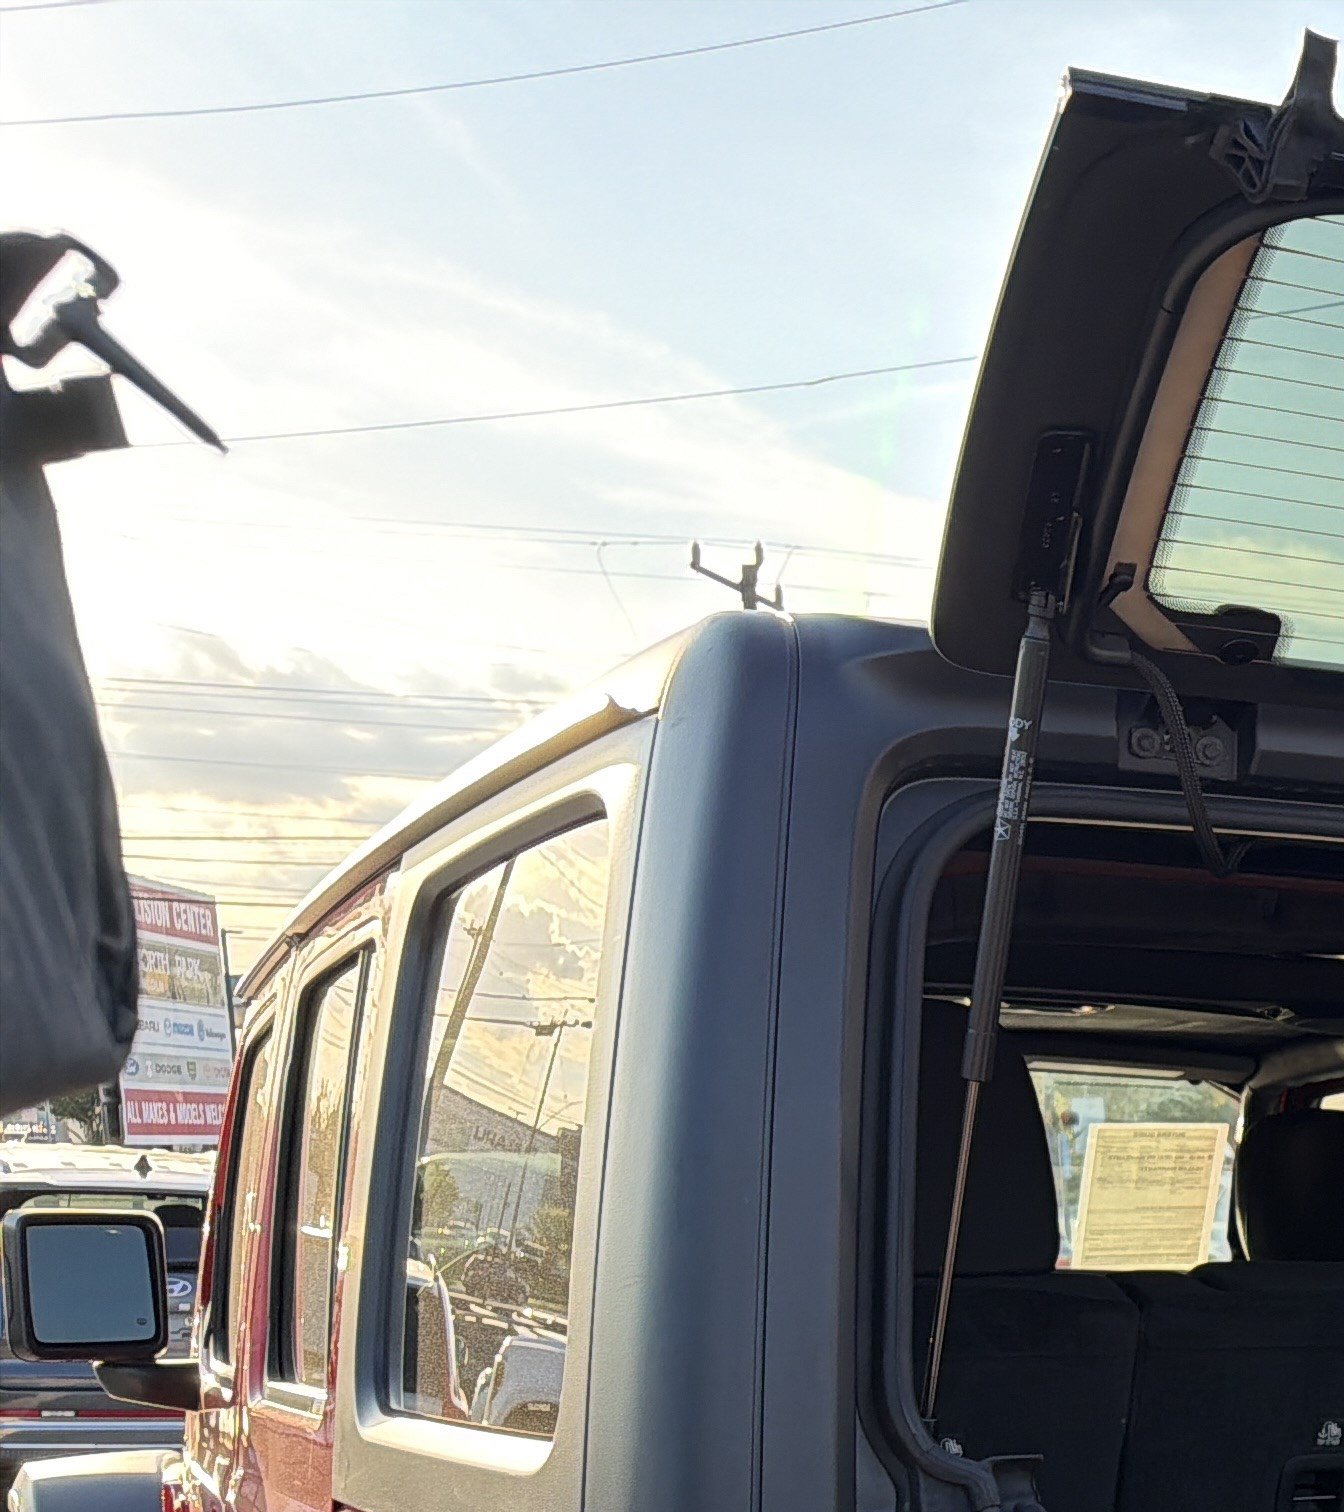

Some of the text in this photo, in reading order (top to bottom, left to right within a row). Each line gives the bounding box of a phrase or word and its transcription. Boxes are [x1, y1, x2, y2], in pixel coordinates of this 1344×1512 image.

[133, 898, 214, 937] LISION CENTER
[127, 1101, 141, 1124] ALL
[142, 1101, 168, 1125] MAKES
[176, 1102, 204, 1125] MODELS
